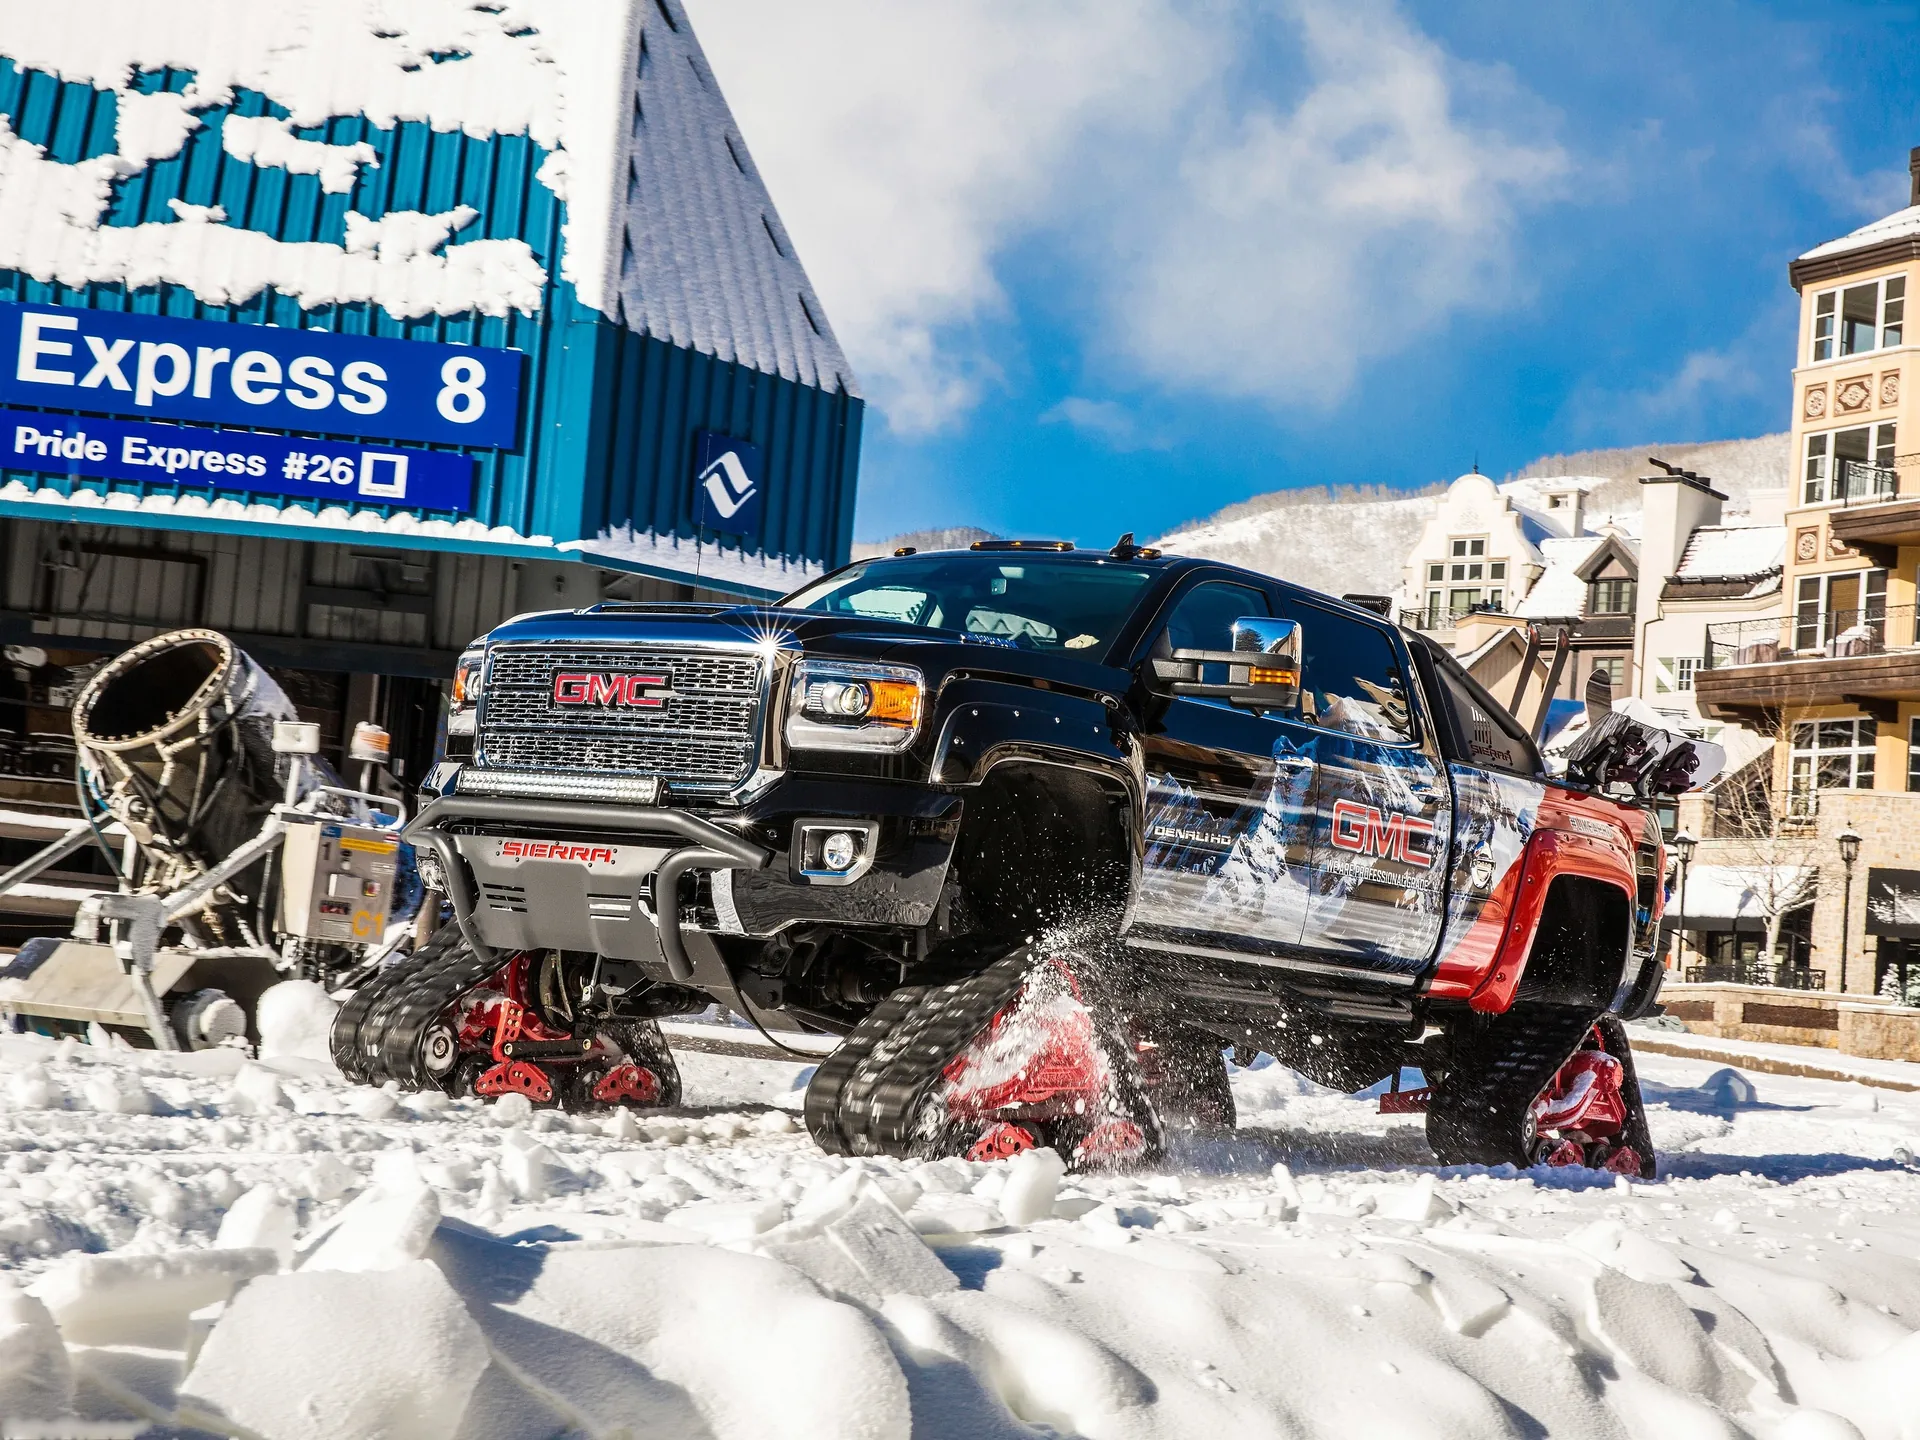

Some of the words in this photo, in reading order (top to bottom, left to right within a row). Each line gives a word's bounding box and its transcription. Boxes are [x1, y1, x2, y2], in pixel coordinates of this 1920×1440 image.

[16, 311, 388, 415] Express
[436, 356, 487, 424] 8
[14, 426, 107, 461] Pride
[121, 436, 267, 476] Express
[281, 451, 355, 485] #26
[554, 672, 669, 708] GMC
[1470, 744, 1513, 763] SIERRA
[1154, 825, 1209, 843] DENALI
[1210, 833, 1232, 846] HD
[1331, 798, 1434, 868] GMC
[502, 841, 613, 863] SIERRA
[1326, 859, 1338, 873] WE
[1339, 862, 1353, 877] ARE
[1354, 865, 1406, 888] PROFESSIONAL
[1406, 876, 1429, 892] GRADE
[352, 910, 384, 937] C1
